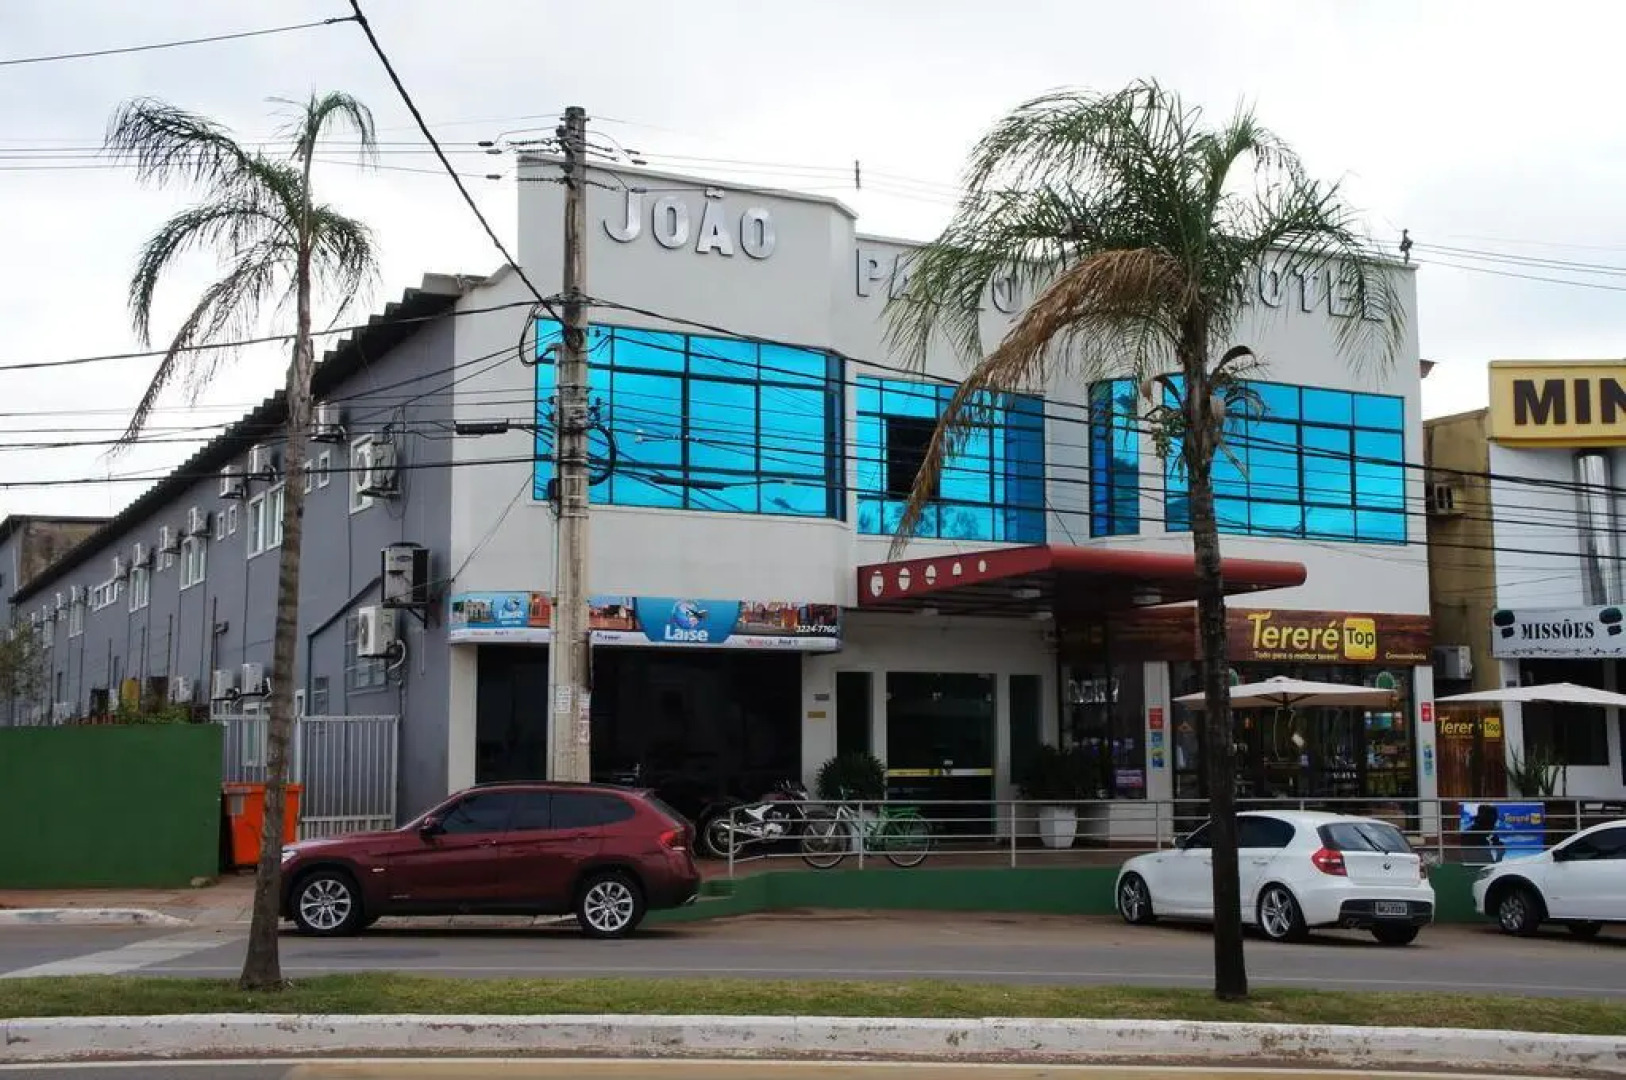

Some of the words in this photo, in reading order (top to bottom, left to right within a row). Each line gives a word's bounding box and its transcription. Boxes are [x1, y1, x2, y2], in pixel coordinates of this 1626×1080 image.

[603, 186, 776, 260] JOÃO
[1512, 377, 1626, 425] MIN
[1247, 610, 1340, 650] Tereré
[1346, 627, 1375, 649] Top
[1520, 618, 1595, 640] MISSÕES
[1438, 716, 1483, 735] Terer
